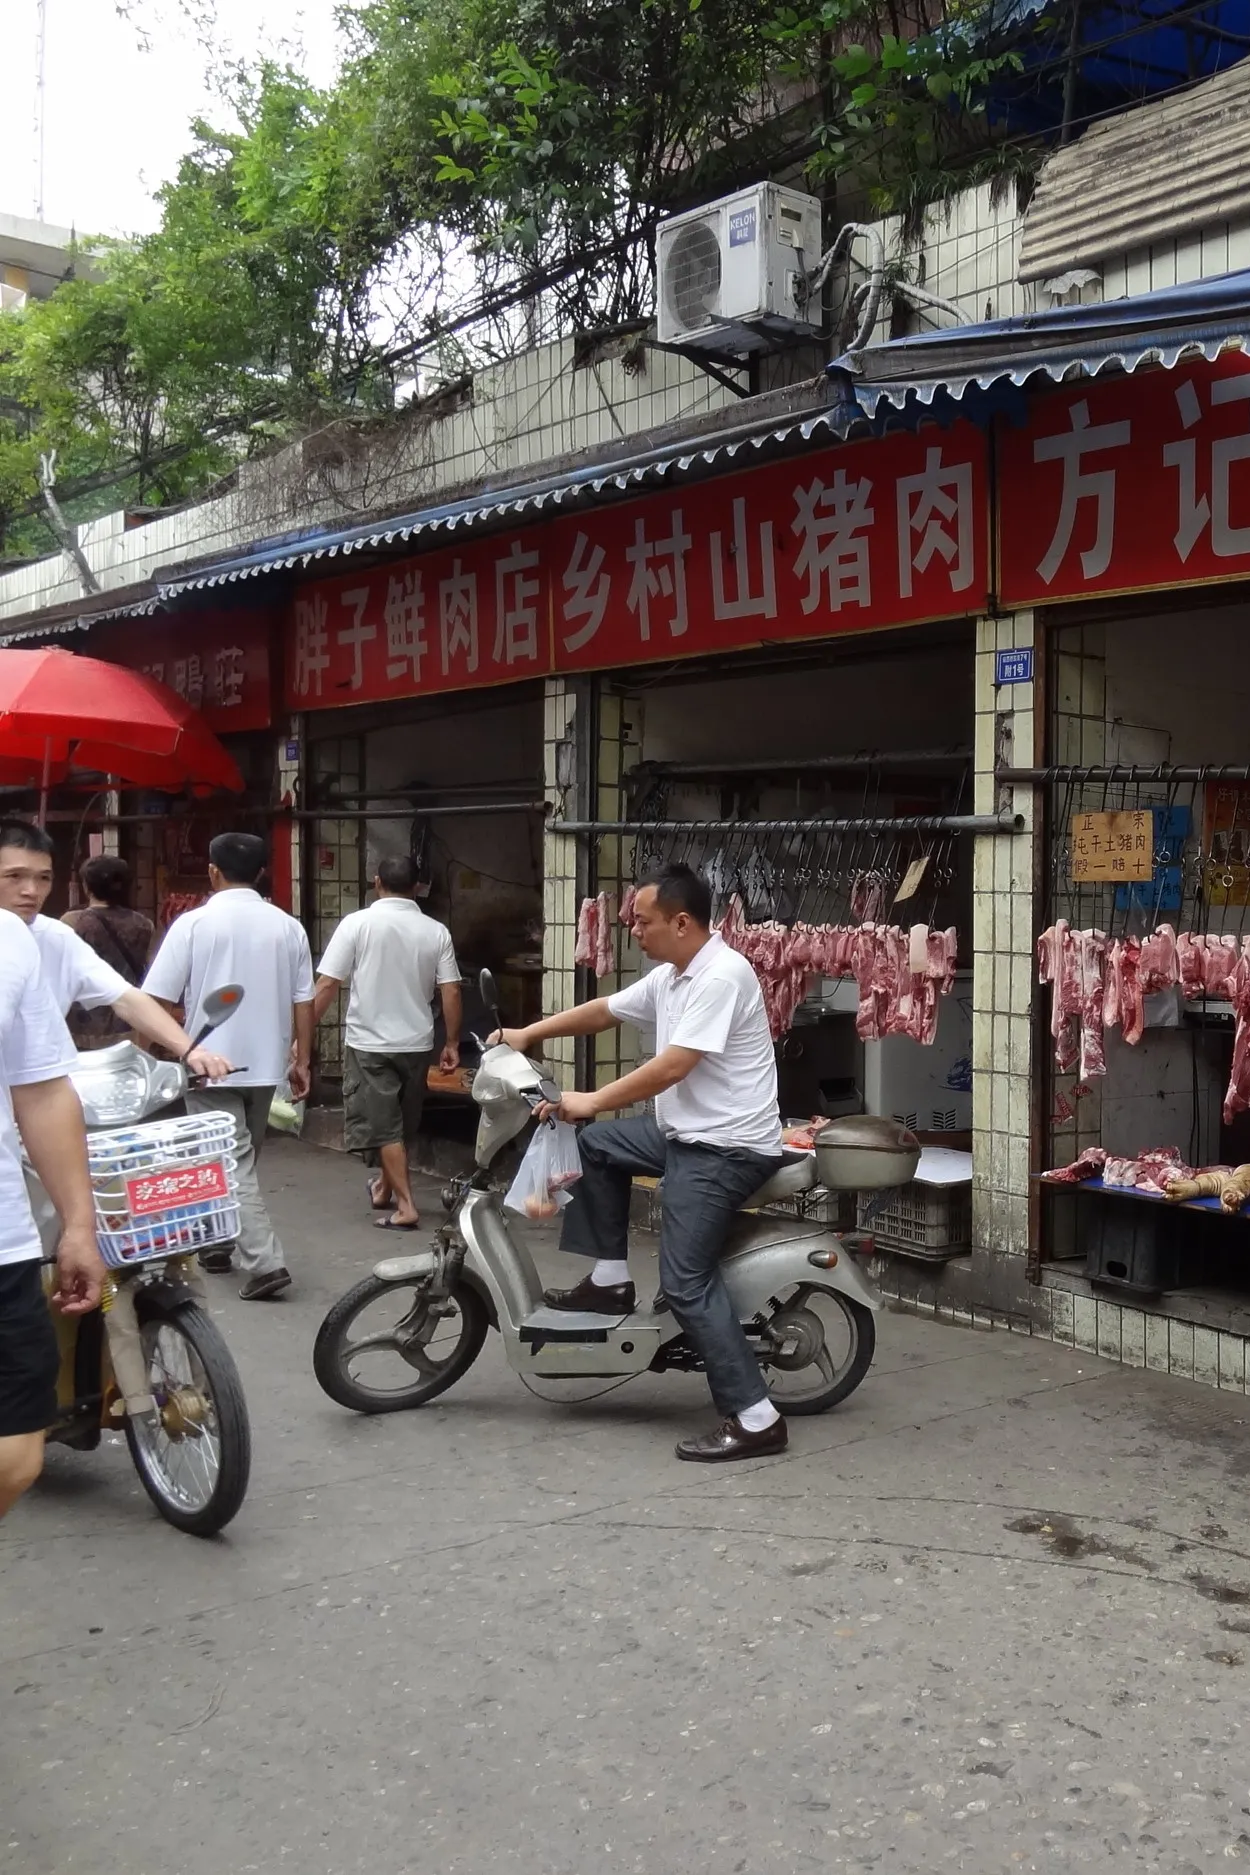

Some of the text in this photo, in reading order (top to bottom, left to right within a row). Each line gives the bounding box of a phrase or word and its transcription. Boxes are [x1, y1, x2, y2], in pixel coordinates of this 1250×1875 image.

[730, 212, 755, 230] KELON
[562, 446, 975, 653] 乡村山猪肉
[293, 540, 540, 697] 胖子鲜肉店
[1074, 857, 1146, 875] 假一赔十
